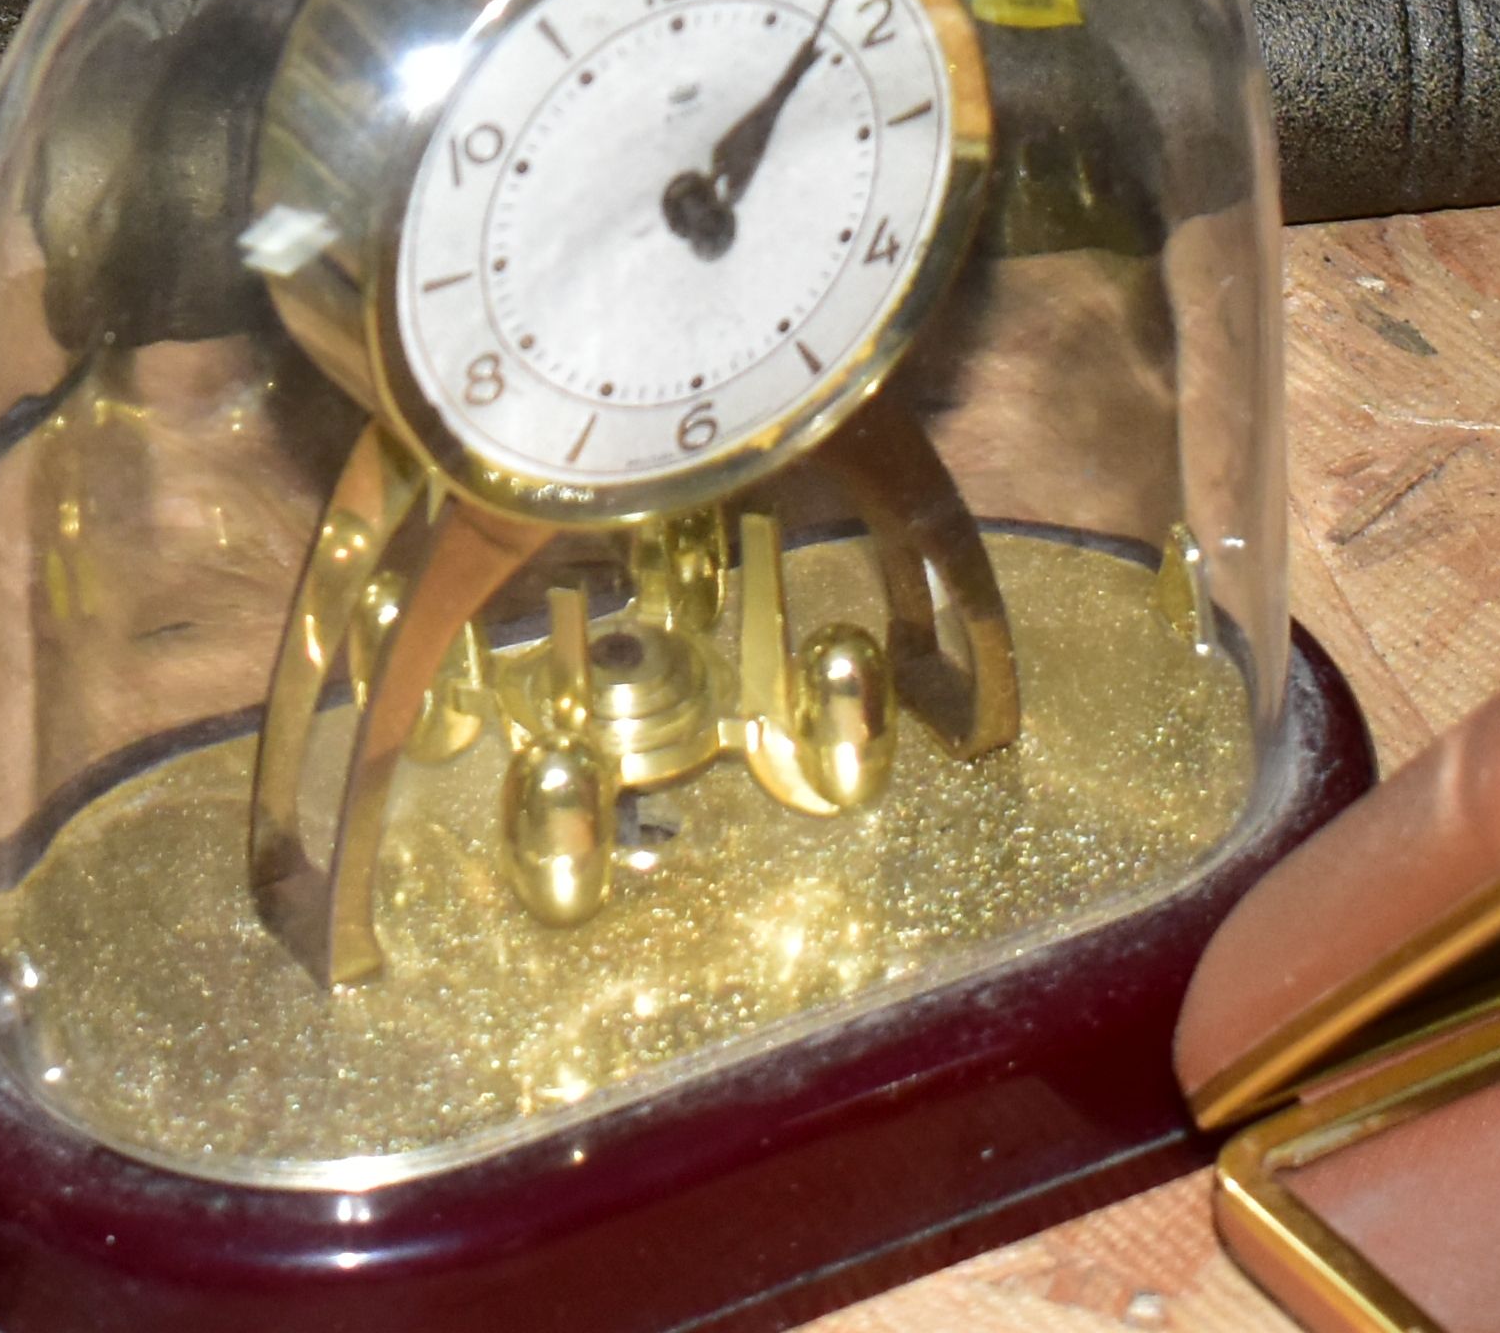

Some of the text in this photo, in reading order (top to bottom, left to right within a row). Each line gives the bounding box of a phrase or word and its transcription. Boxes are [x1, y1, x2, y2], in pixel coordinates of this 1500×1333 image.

[447, 121, 506, 186] 10
[863, 215, 901, 267] 4
[460, 353, 508, 408] 8
[676, 399, 719, 454] 6
